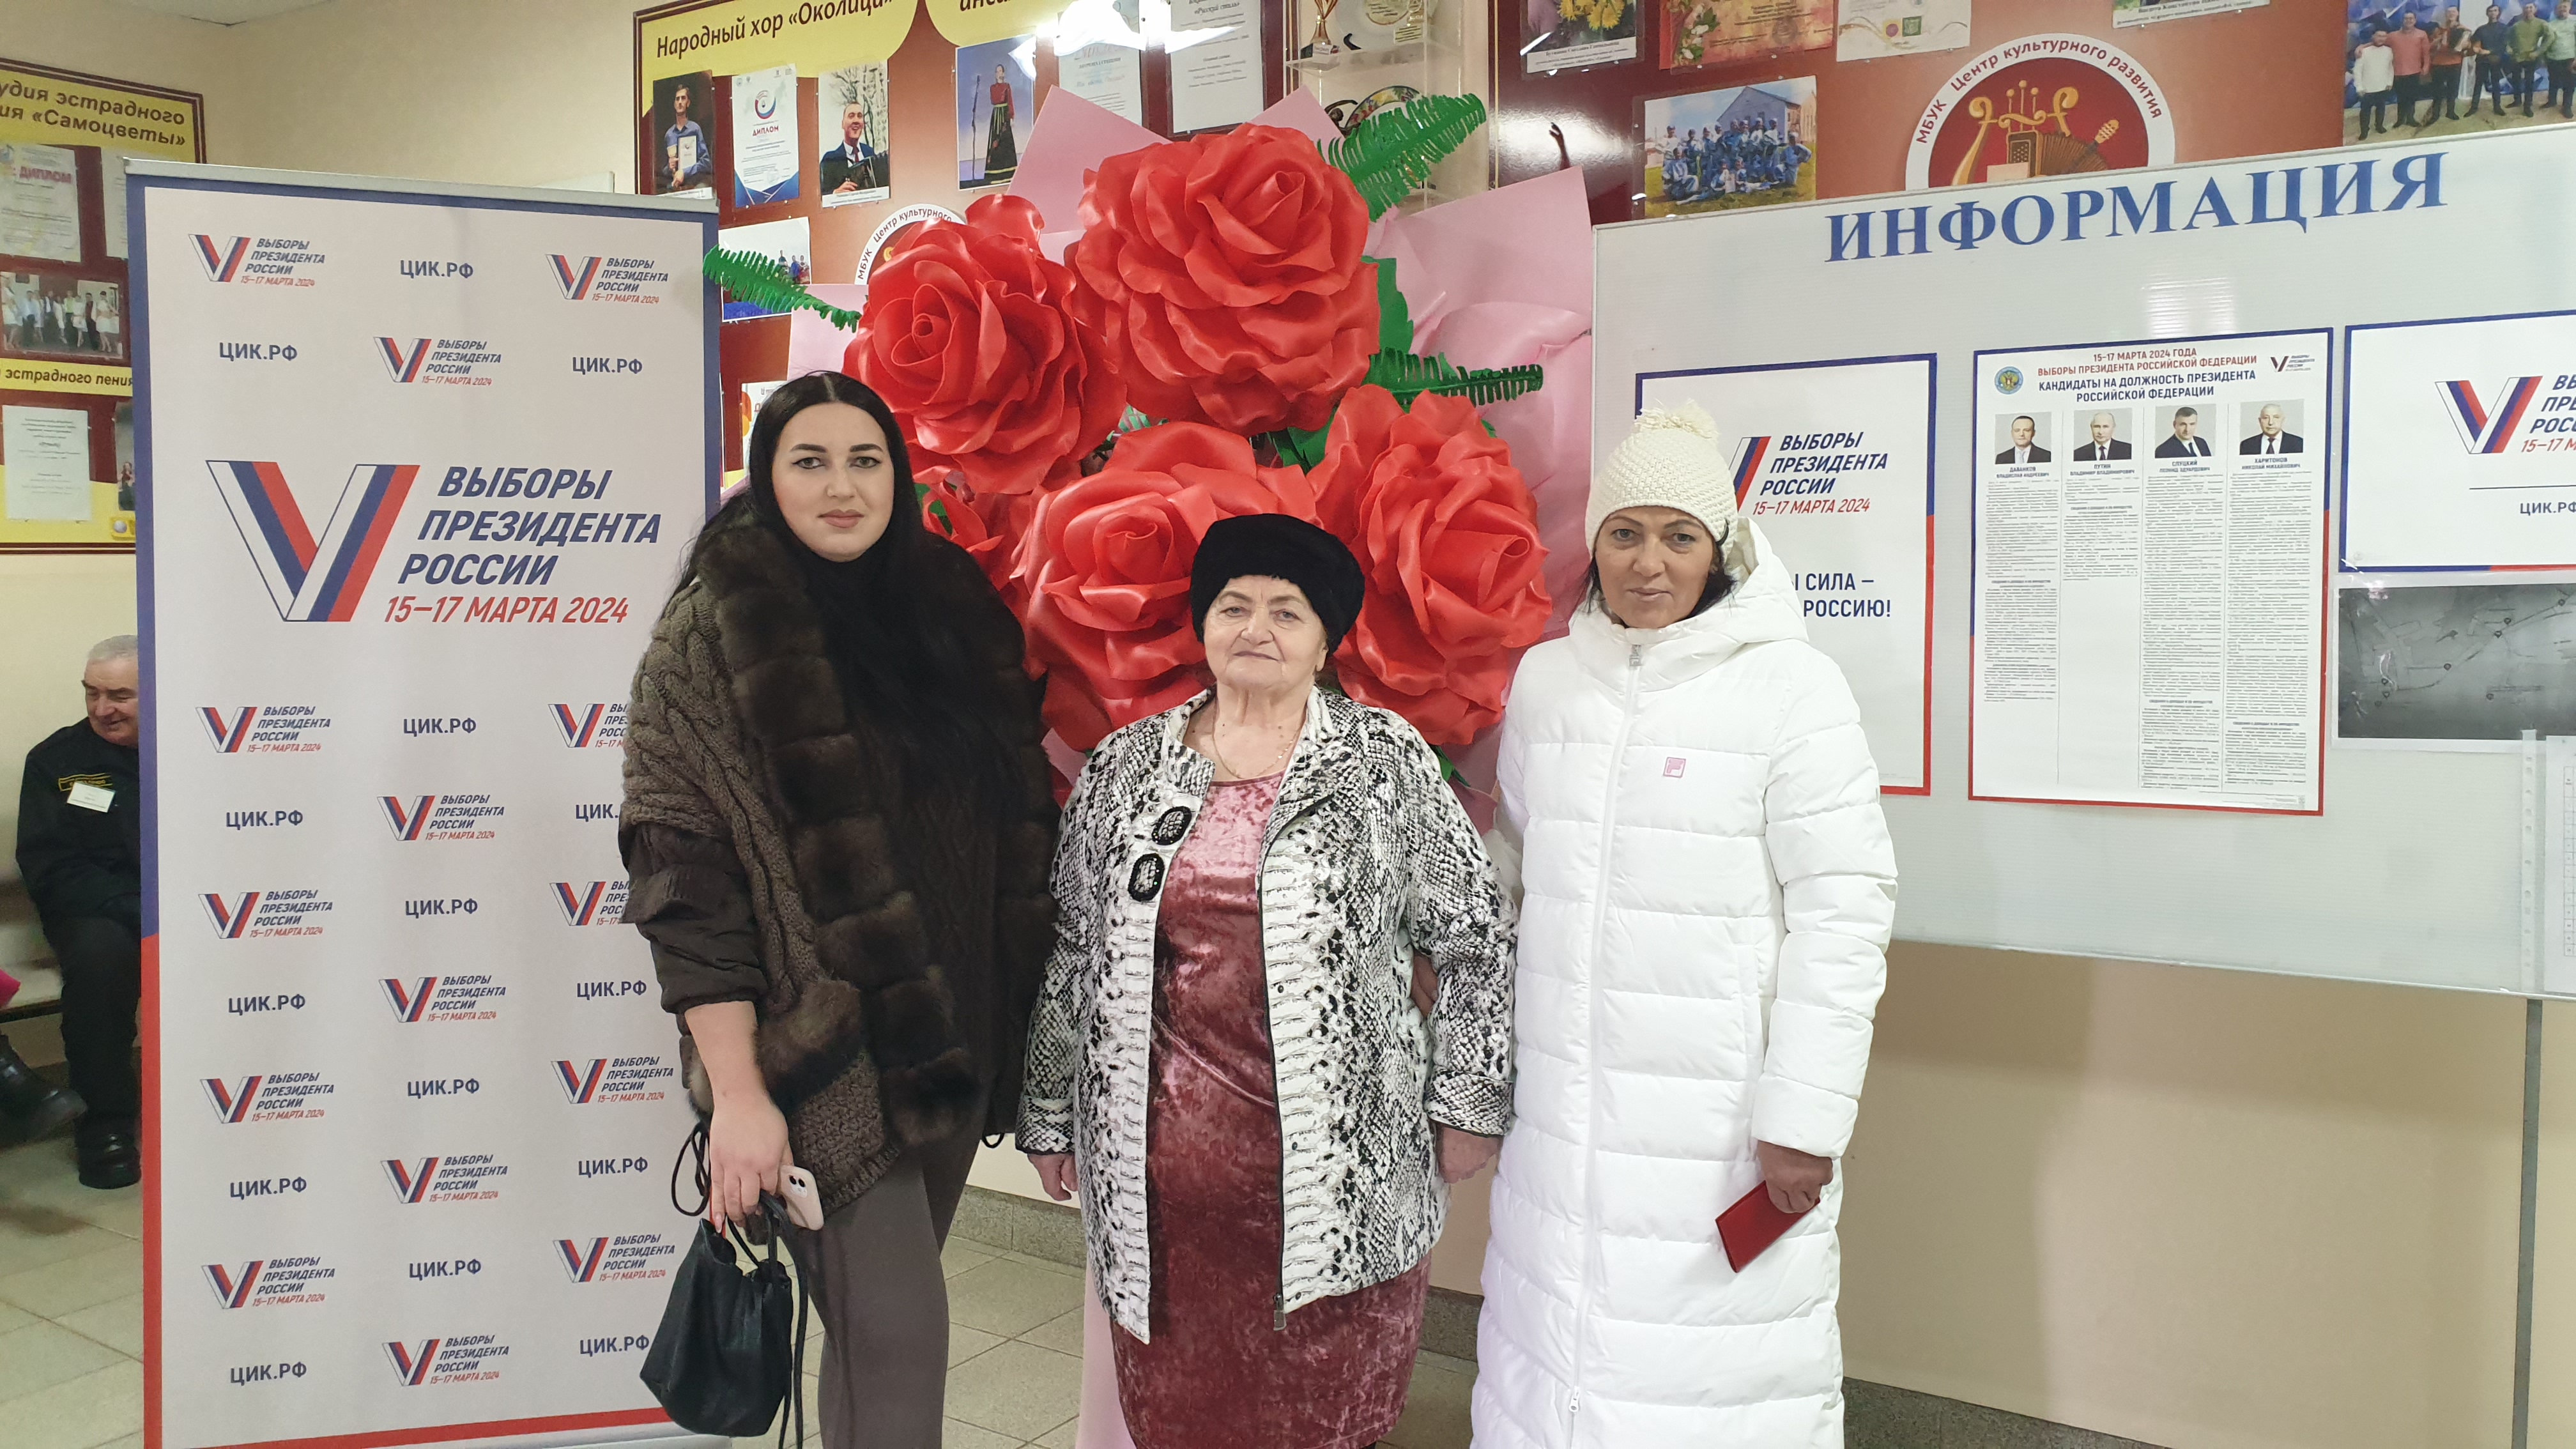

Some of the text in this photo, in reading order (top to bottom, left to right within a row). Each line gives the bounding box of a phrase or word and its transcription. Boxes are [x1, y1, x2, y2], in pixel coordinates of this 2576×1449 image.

[657, 15, 746, 60] Народный
[749, 14, 783, 38] хор
[1916, 40, 2163, 144] МБУК Центр культурного развития
[56, 92, 185, 125] эстрадного
[32, 109, 186, 146] «Самоцветы»
[752, 125, 779, 136] ДИПЛОМ
[1825, 151, 2450, 263] ИНФОРМАЦИЯ
[257, 238, 310, 249] ВЫБОРЫ
[857, 248, 873, 280] МБУК
[873, 217, 898, 243] Центр
[251, 251, 325, 263] ПРЕЗИДЕНТА
[606, 258, 654, 268] ВЫБОРЫ
[245, 264, 293, 274] РОССИИ
[401, 260, 473, 279] ЦИК.РФ
[601, 270, 668, 281] ПРЕЗИДЕНТА
[596, 282, 639, 292] РОССИИ
[437, 339, 487, 349] ВЫБОРЫ
[220, 342, 297, 362] ЦИК.РФ
[431, 352, 501, 363] ПРЕЗИДЕНТА
[2117, 352, 2147, 361] МАРТА
[2149, 350, 2170, 358] 2024
[2173, 348, 2196, 357] ГОДА
[425, 364, 471, 374] РОССИИ
[573, 357, 642, 375] ЦИК.РФ
[2038, 355, 2257, 376] ВЫБОРЫ ПРЕЗИДЕНТА РОССИЙСКОЙ ФЕДЕРАЦИИ
[5, 369, 92, 384] эстрадного
[2039, 370, 2257, 391] КАНДИДАТЫ НА ДОЛЖНОСТЬ ПРЕЗИДЕНТА
[2076, 386, 2214, 402] РОССИЙСКОЙ ФЕДЕРАЦИИ
[1779, 432, 1864, 451] ВЫБОРЫ
[1770, 453, 1888, 473] ПРЕЗИДЕНТА
[438, 466, 613, 499] ВЫБОРЫ
[1759, 478, 1836, 496] РОССИИ
[1790, 499, 1836, 514] МАРТА
[1837, 498, 1870, 512] 2024
[418, 510, 661, 547] ПРЕЗИДЕНТА
[398, 554, 558, 585] РОССИИ
[1805, 572, 1856, 590] СИЛА
[464, 597, 556, 623] МАРТА
[562, 597, 628, 623] 2024
[1804, 599, 1890, 617] РОССИЮ!
[263, 707, 316, 716] ВЫБОРЫ
[257, 719, 330, 729] ПРЕЗИДЕНТА
[404, 717, 476, 737] ЦИК.РФ
[251, 732, 300, 741] РОССИИ
[272, 744, 300, 752] МАРТА
[441, 795, 490, 804] ВЫБОРЫ
[435, 807, 504, 817] ПРЕЗИДЕНТА
[576, 804, 618, 822] ЦИК.
[226, 810, 303, 831] ЦИК.РФ
[429, 820, 475, 829] РОССИИ
[266, 890, 318, 900] ВЫБОРЫ
[259, 902, 332, 914] ПРЕЗИДЕНТА
[406, 898, 477, 919] ЦИК.РФ
[254, 916, 302, 926] РОССИИ
[274, 928, 302, 936] МАРТА
[442, 976, 491, 985] ВЫБОРЫ
[437, 987, 506, 998] ПРЕЗИДЕНТА
[578, 980, 647, 1000] ЦИК.РФ
[229, 994, 305, 1016] ЦИК.РФ
[431, 1000, 476, 1011] РОССИИ
[450, 1012, 476, 1020] МАРТА
[612, 1057, 659, 1067] ВЫБОРЫ
[268, 1073, 319, 1084] ВЫБОРЫ
[606, 1068, 673, 1079] ПРЕЗИДЕНТА
[262, 1085, 334, 1097] ПРЕЗИДЕНТА
[408, 1078, 479, 1099] ЦИК.РФ
[601, 1082, 645, 1092] РОССИИ
[620, 1093, 645, 1101] МАРТА
[256, 1098, 303, 1110] РОССИИ
[275, 1110, 303, 1119] МАРТА
[444, 1154, 493, 1165] ВЫБОРЫ
[439, 1166, 507, 1178] ПРЕЗИДЕНТА
[579, 1157, 648, 1178] ЦИК.РФ
[231, 1177, 307, 1200] ЦИК.РФ
[433, 1180, 478, 1191] РОССИИ
[452, 1192, 478, 1200] МАРТА
[613, 1234, 661, 1245] ВЫБОРЫ
[608, 1245, 675, 1258] ПРЕЗИДЕНТА
[269, 1257, 321, 1269] ВЫБОРЫ
[603, 1259, 646, 1270] РОССИИ
[263, 1268, 335, 1282] ПРЕЗИДЕНТА
[410, 1259, 481, 1281] ЦИК.РФ
[257, 1283, 304, 1295] РОССИИ
[276, 1295, 303, 1304] МАРТА
[445, 1335, 495, 1347] ВЫБОРЫ
[580, 1335, 648, 1357] ЦИК.РФ
[440, 1346, 509, 1360] ПРЕЗИДЕНТА
[434, 1361, 479, 1372] РОССИИ
[231, 1361, 307, 1386] ЦИК.РФ
[453, 1373, 479, 1382] МАРТА
